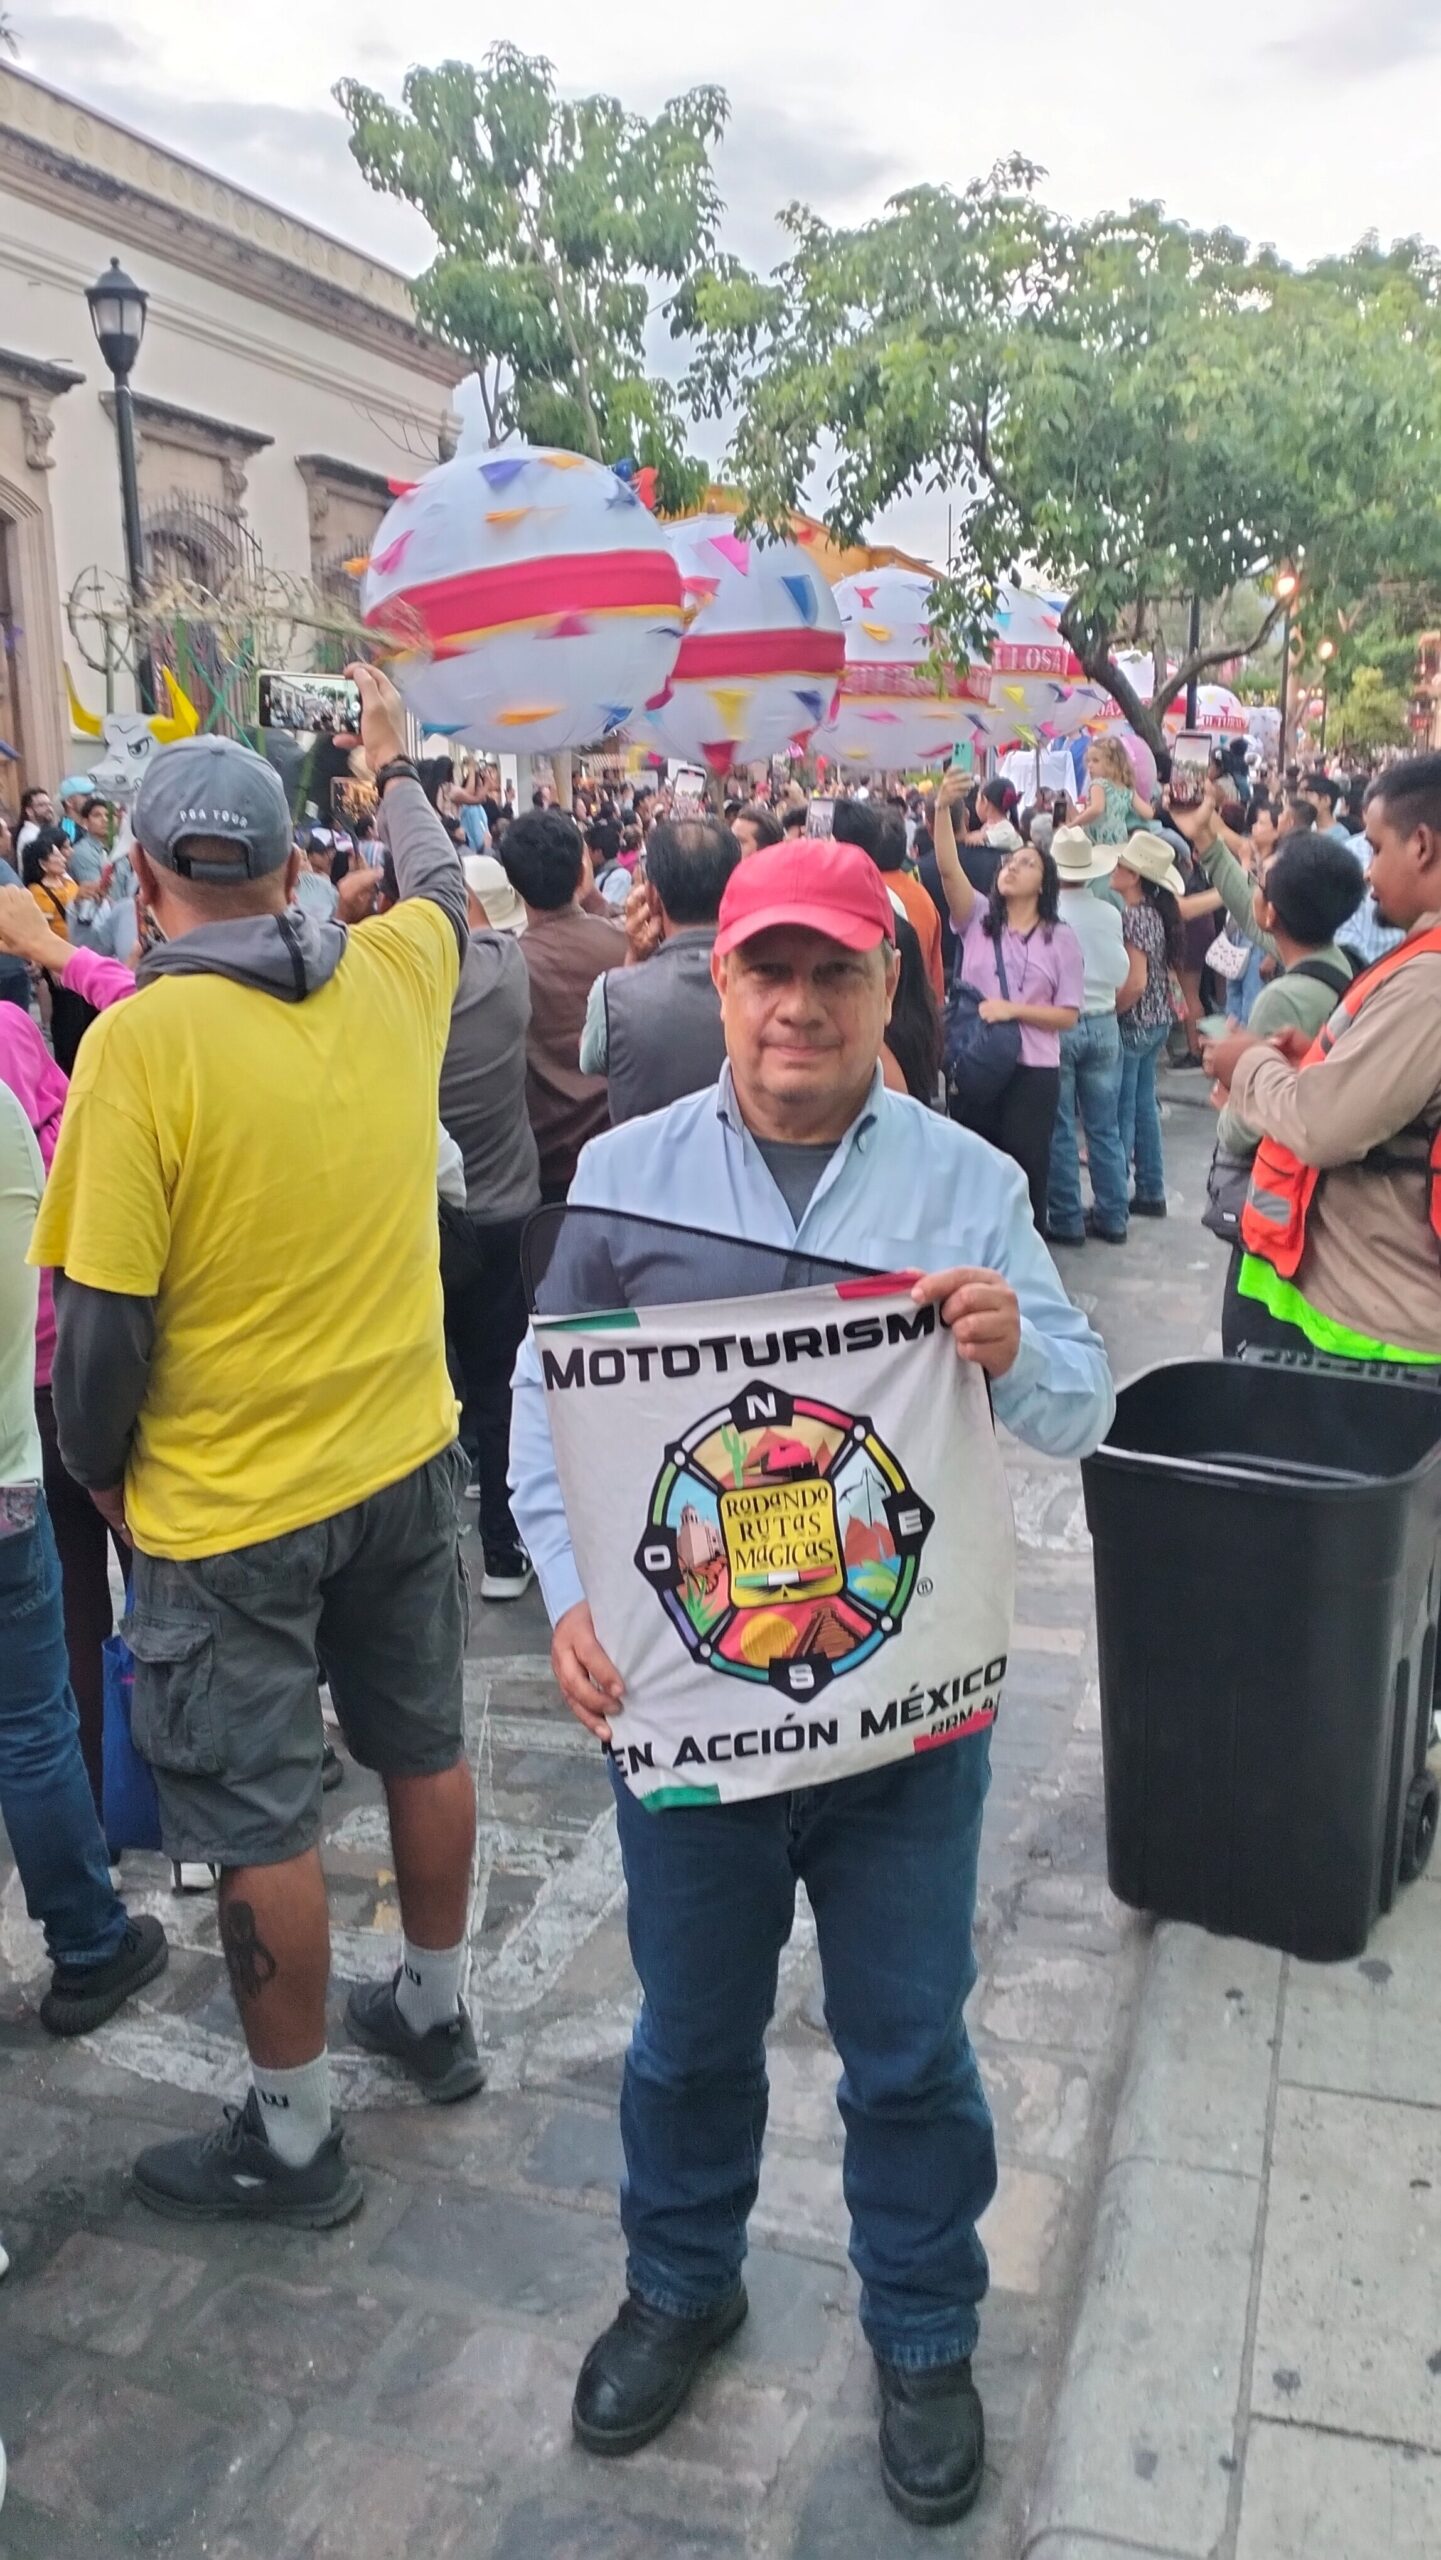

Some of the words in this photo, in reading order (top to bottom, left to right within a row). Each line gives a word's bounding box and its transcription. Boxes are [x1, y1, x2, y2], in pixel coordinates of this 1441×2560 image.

[541, 1303, 952, 1391] MOTOTURISM
[747, 1393, 777, 1420] N
[898, 1509, 923, 1535] E
[788, 1663, 815, 1690] S
[611, 1742, 655, 1778] EN
[672, 1711, 839, 1768] ACCIÓN
[860, 1653, 1008, 1740] MÉXICO
